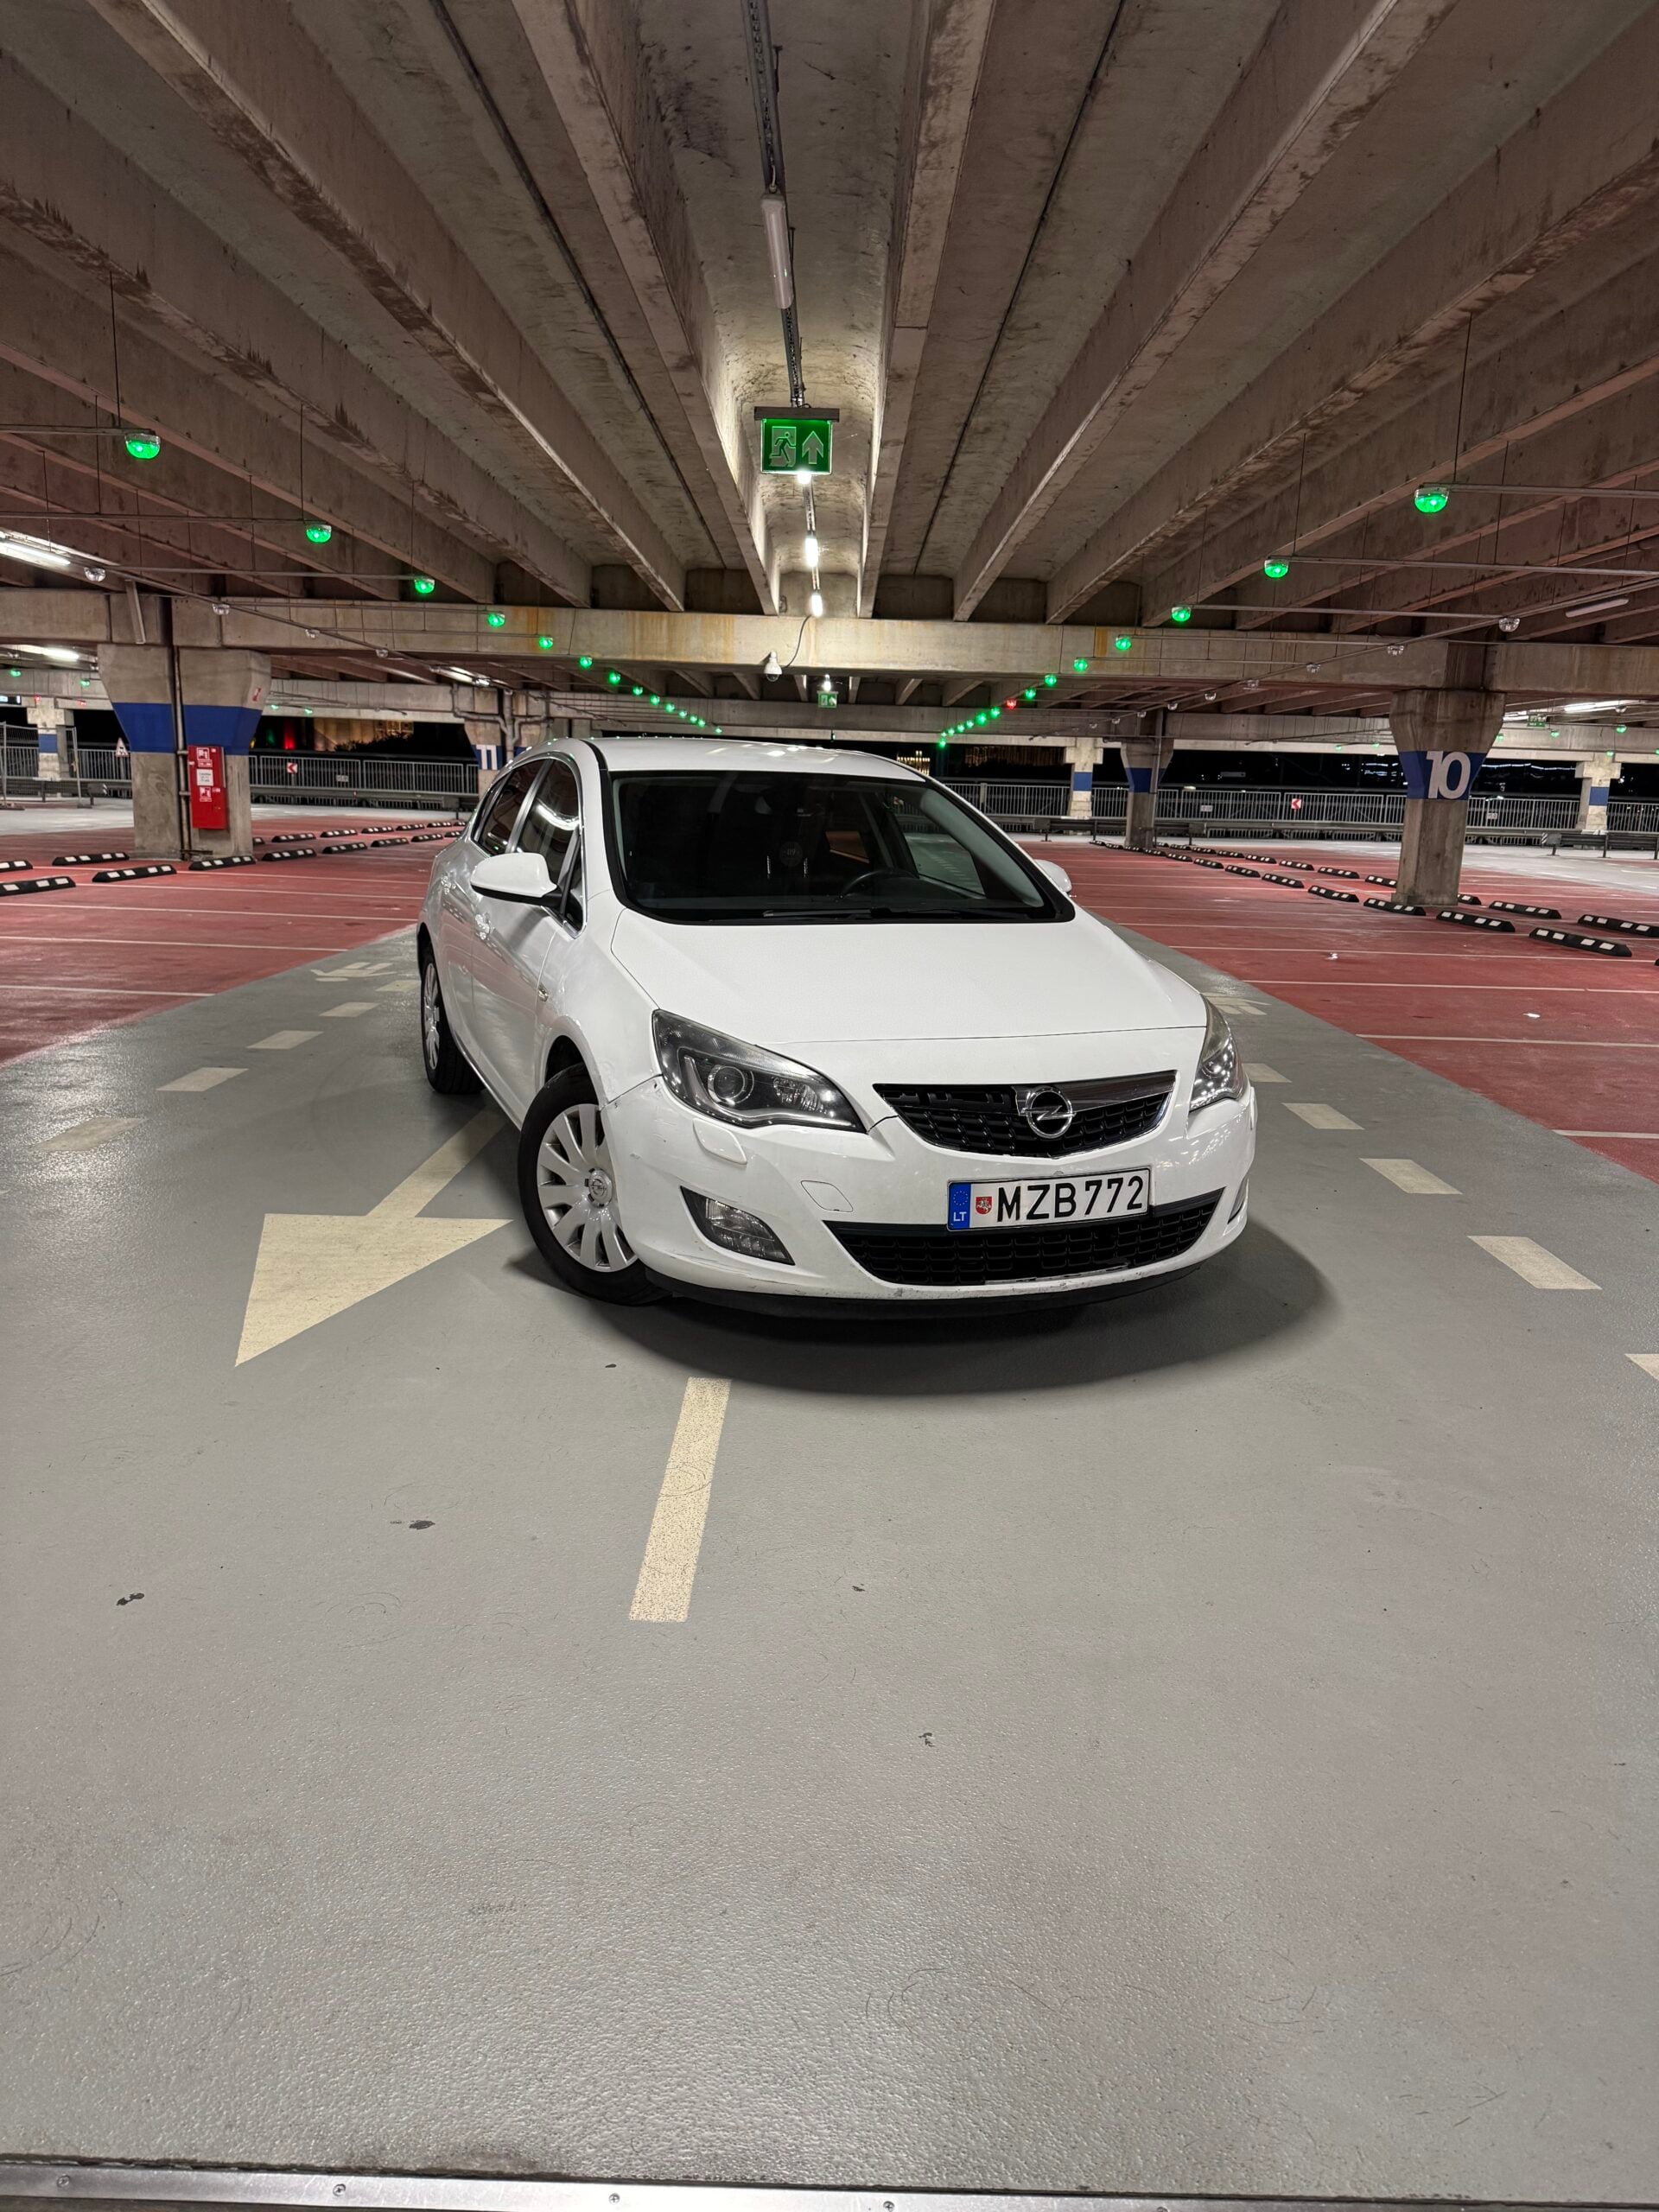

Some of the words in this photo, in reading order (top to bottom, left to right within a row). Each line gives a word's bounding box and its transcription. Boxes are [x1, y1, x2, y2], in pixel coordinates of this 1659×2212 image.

[476, 744, 498, 771] 11
[1426, 751, 1471, 799] 10
[953, 1211, 967, 1222] LT
[997, 1175, 1144, 1223] MZB772
